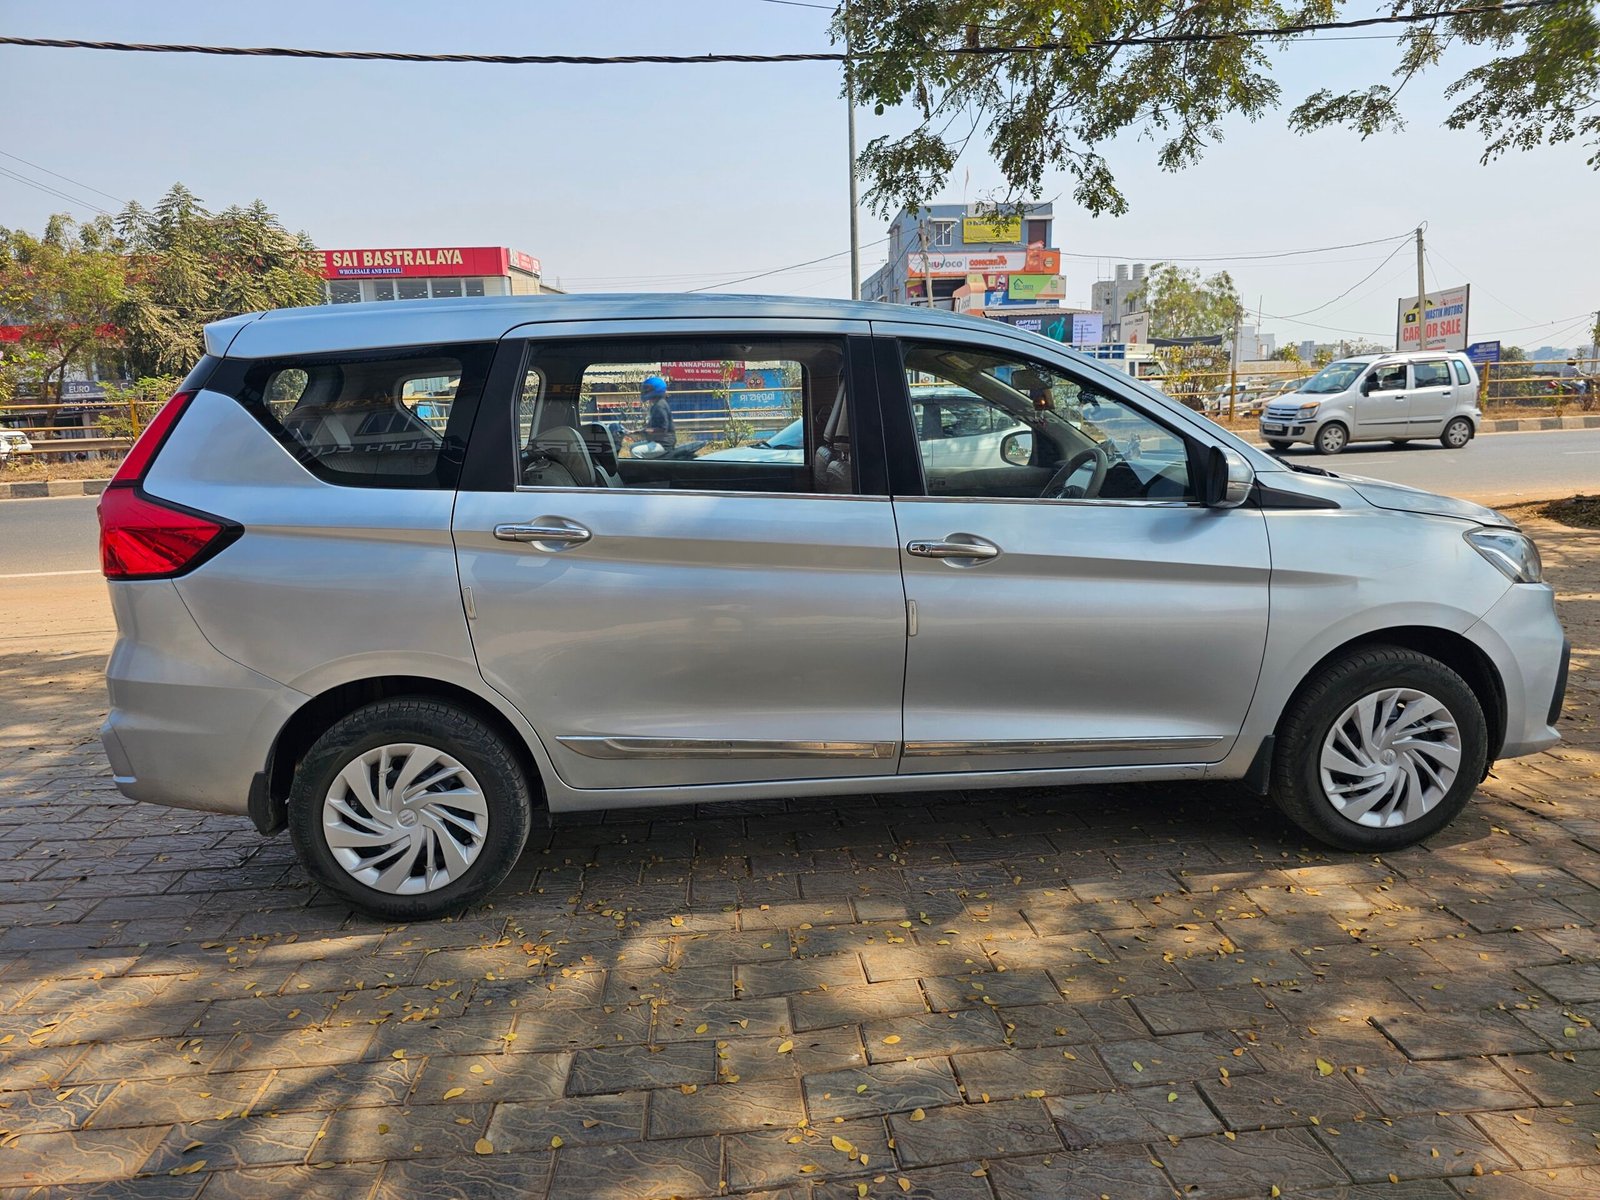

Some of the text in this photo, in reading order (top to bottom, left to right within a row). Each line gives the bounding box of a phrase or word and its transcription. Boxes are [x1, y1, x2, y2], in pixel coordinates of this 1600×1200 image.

[333, 252, 358, 267] SAI
[363, 249, 464, 267] BASTRALAYA
[1424, 307, 1443, 320] WASTIK
[1440, 318, 1461, 336] SALE
[678, 360, 721, 368] ANNAPURNA
[68, 385, 90, 394] EURO
